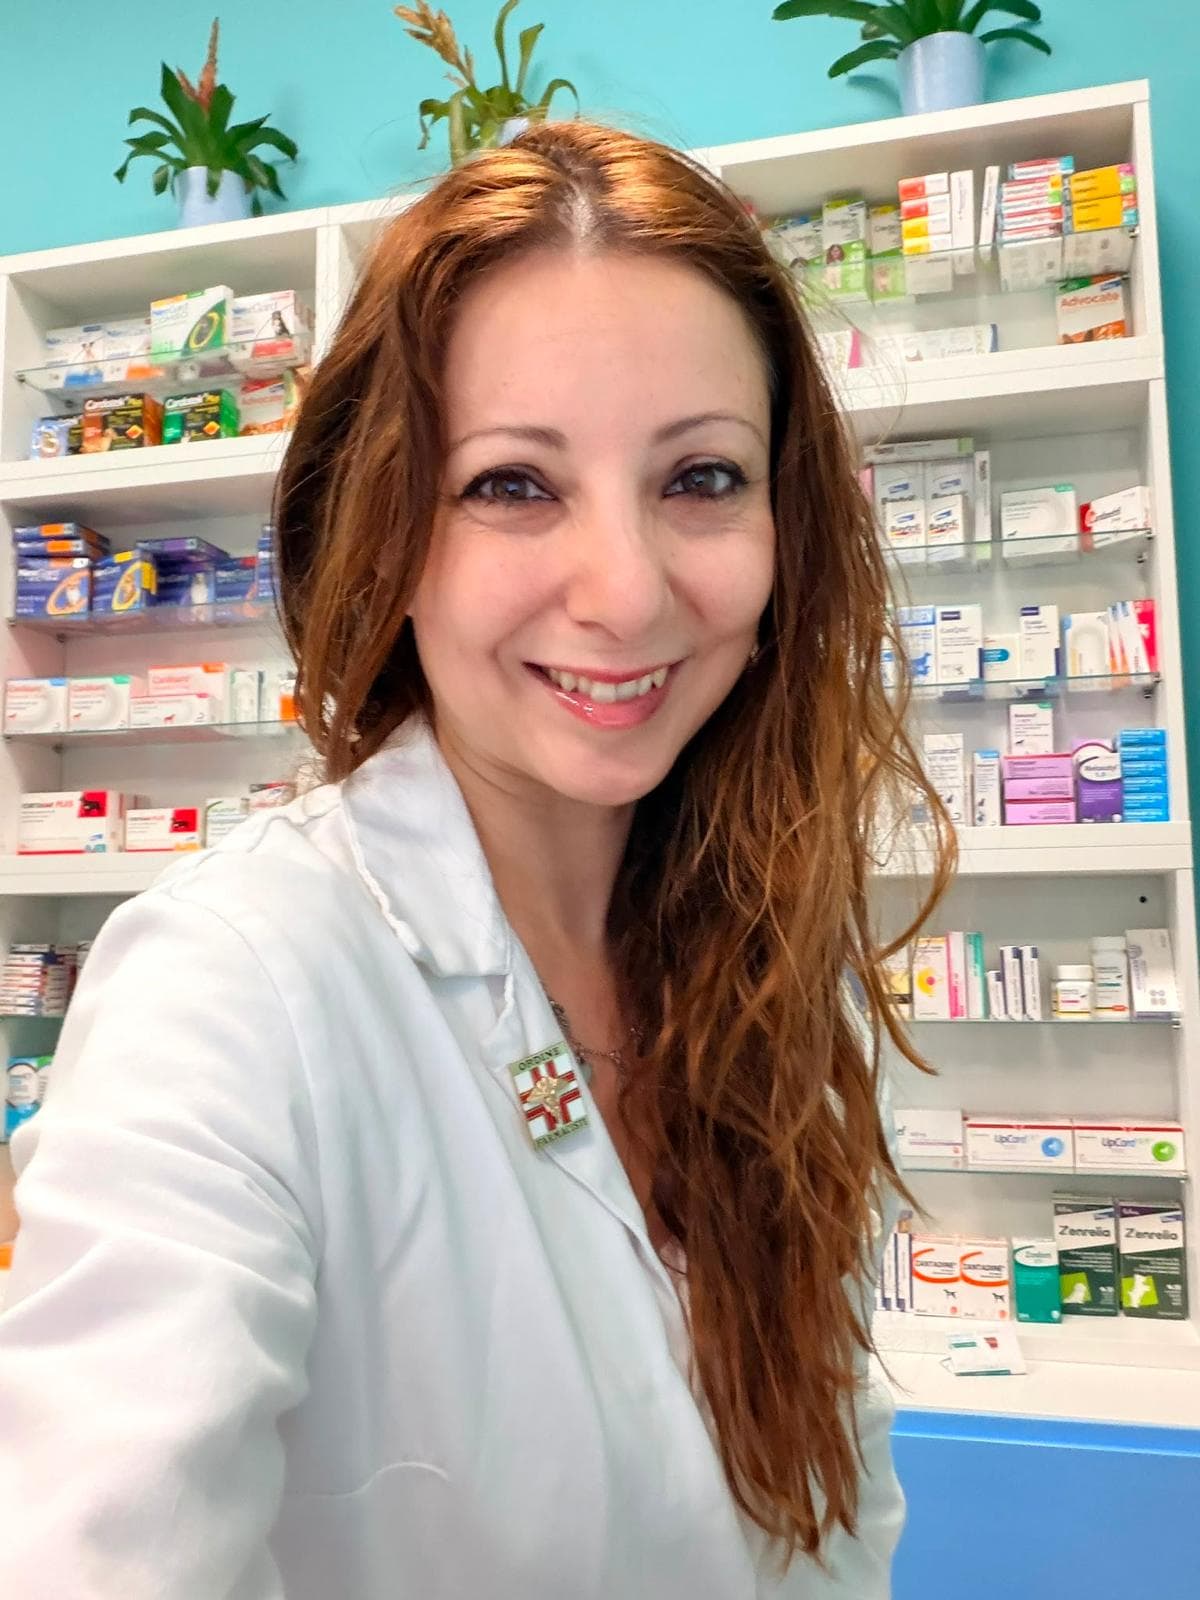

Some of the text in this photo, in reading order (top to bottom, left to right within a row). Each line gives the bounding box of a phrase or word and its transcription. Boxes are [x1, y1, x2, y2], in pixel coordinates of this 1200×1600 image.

[1061, 292, 1120, 307] Advocate
[518, 1046, 561, 1071] ORDINE
[1059, 1225, 1112, 1238] Zenrelia
[1125, 1228, 1178, 1241] Zenrelia
